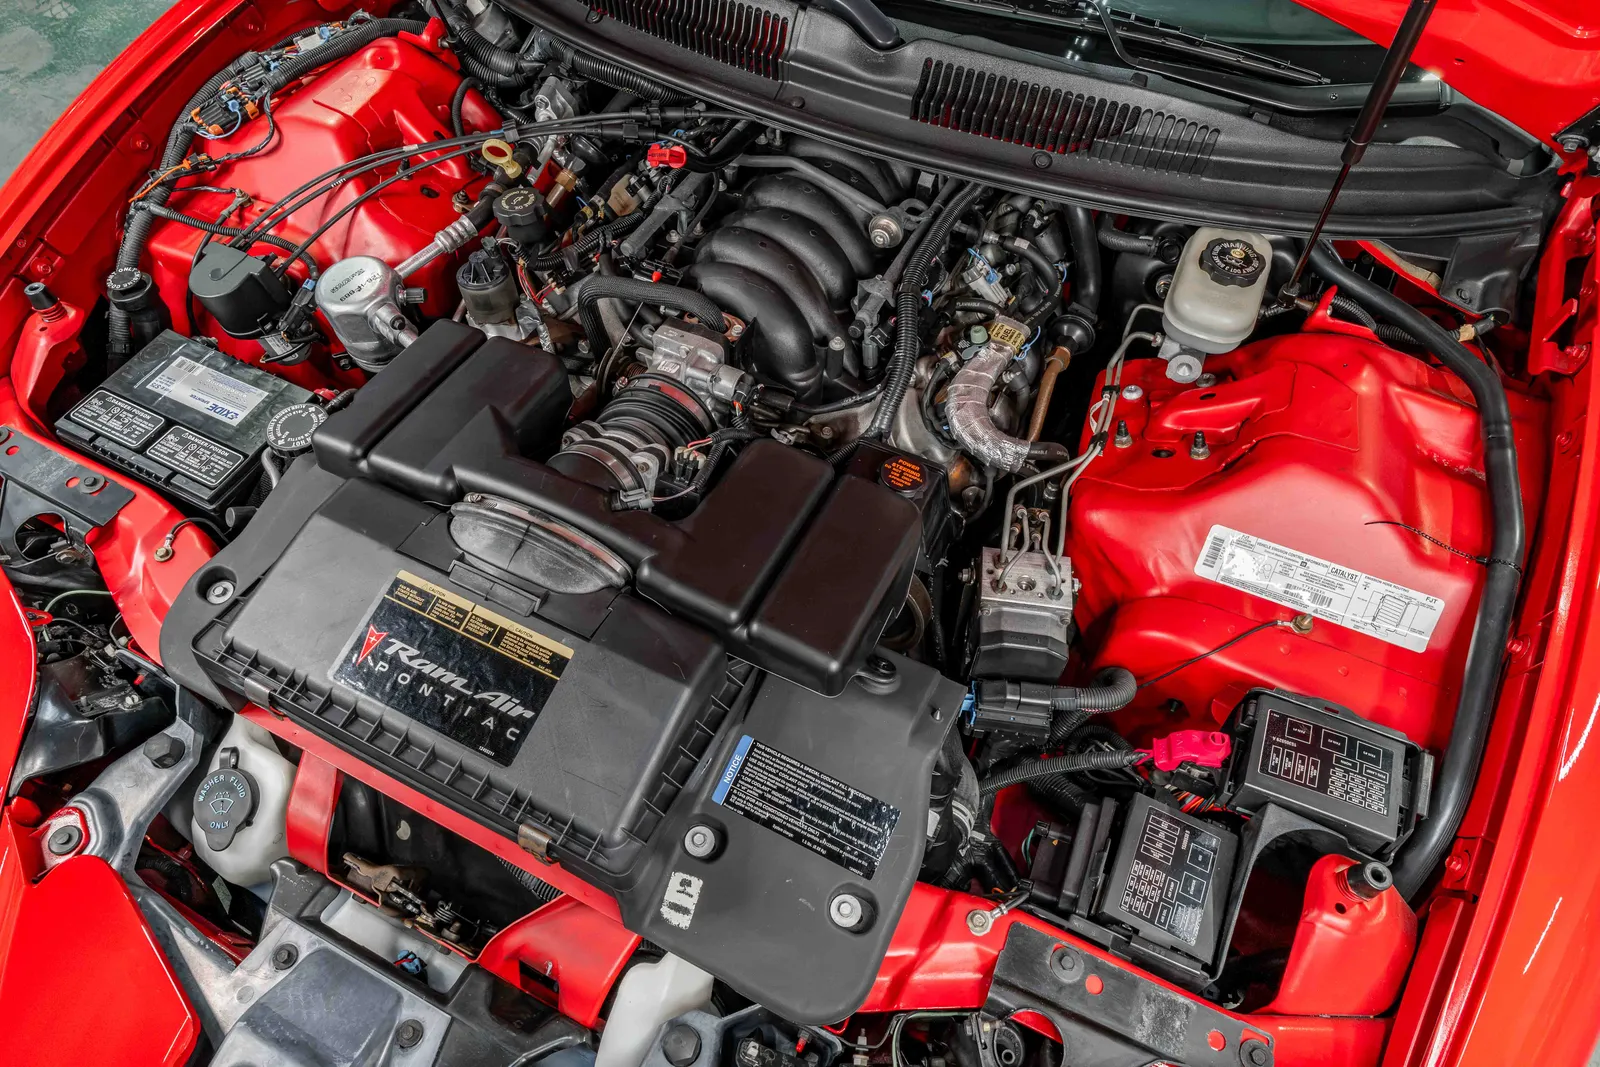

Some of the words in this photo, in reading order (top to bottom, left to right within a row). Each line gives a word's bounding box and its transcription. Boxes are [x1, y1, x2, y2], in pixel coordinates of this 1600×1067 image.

[1221, 242, 1256, 257] WARNING
[1000, 326, 1012, 341] FUEL
[188, 393, 210, 404] SPRINTER
[205, 402, 240, 420] EXIDE
[891, 462, 920, 477] STEERING
[898, 458, 919, 470] POWER
[1329, 566, 1358, 581] CATALYST
[427, 586, 446, 597] CAUTION
[1425, 596, 1438, 604] FJT
[514, 627, 533, 639] CAUTION
[384, 638, 473, 695] Ram
[473, 691, 536, 719] Air
[375, 661, 520, 741] PONTIAC
[723, 753, 742, 783] NOTICE
[764, 746, 781, 757] VEHICLE
[780, 754, 800, 766] REQUIRES
[803, 765, 820, 776] SPECIAL
[820, 773, 838, 786] COOLANT
[198, 774, 224, 801] WASHER
[229, 776, 245, 797] FLUID
[778, 771, 797, 783] COOLANT
[796, 780, 808, 789] ONLY
[209, 820, 229, 828] ONLY
